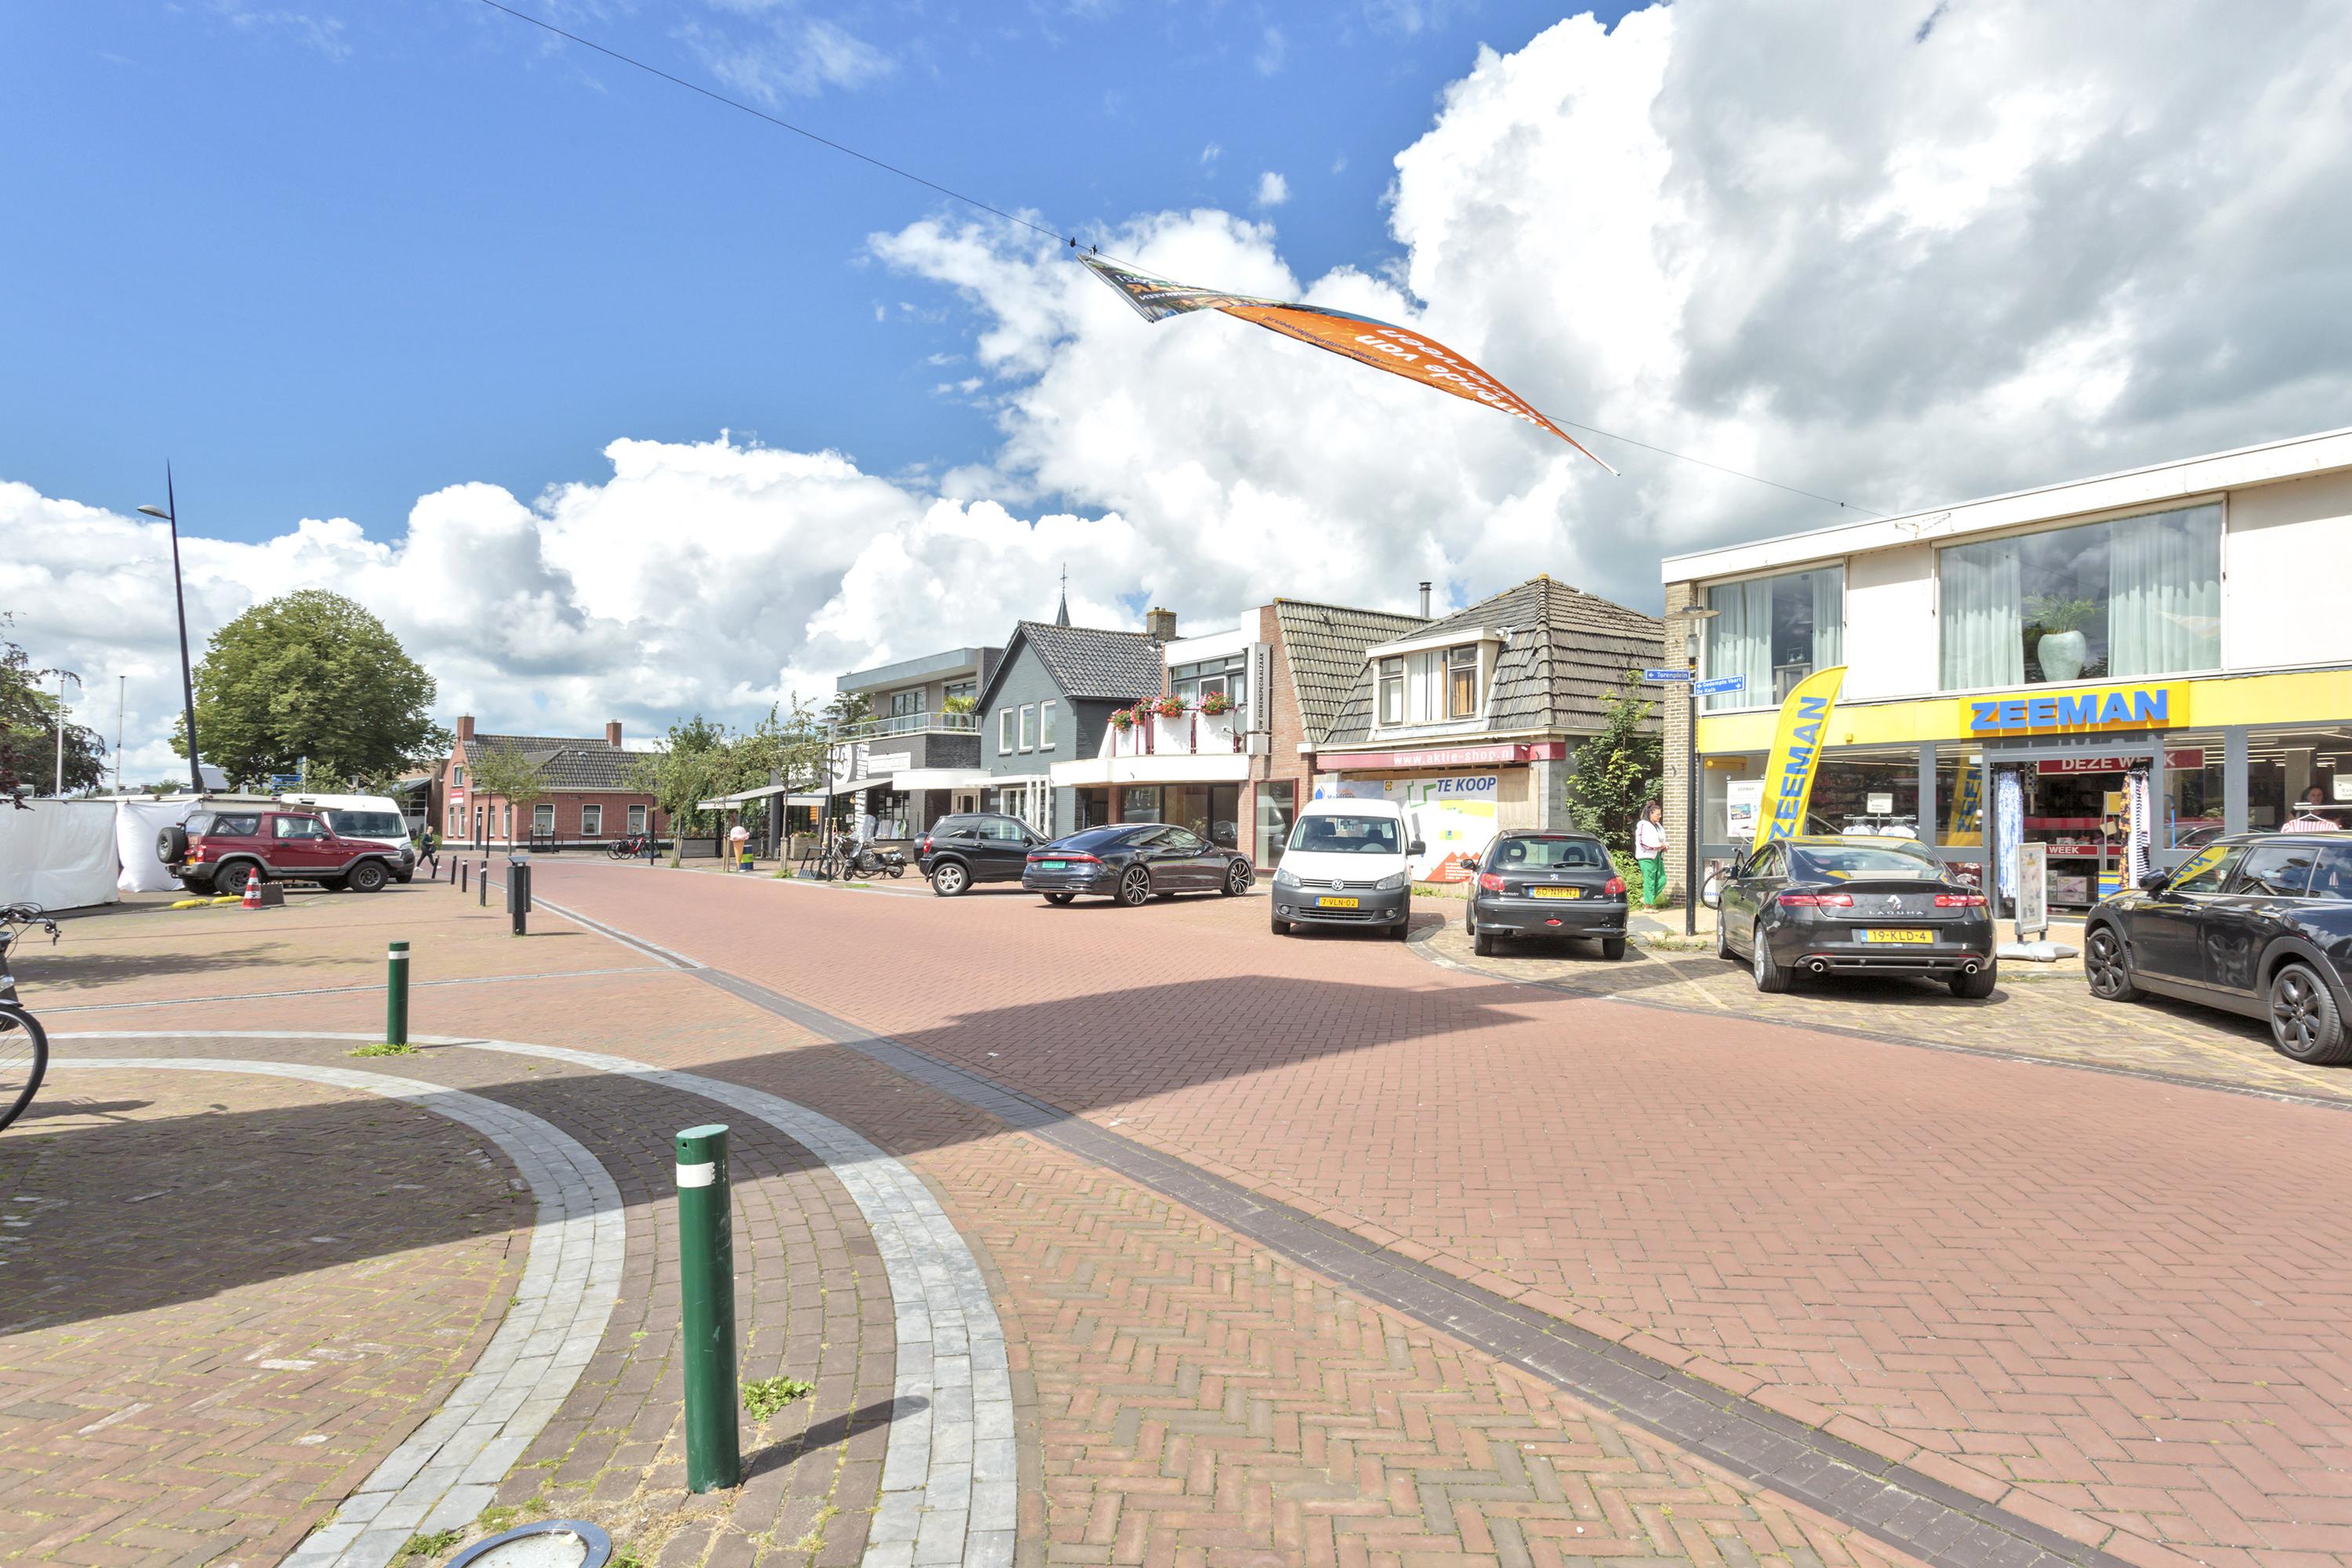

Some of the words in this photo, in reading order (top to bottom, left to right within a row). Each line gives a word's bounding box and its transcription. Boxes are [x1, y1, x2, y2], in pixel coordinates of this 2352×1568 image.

[1354, 334, 1420, 362] van
[1970, 689, 2168, 730] ZEEMAN
[1258, 720, 1264, 730] UW
[1393, 746, 1514, 765] www.aktie-shop.nl
[2062, 757, 2113, 771] DEZE
[2118, 753, 2176, 768] WK
[1768, 696, 1828, 841] ZEEMAN
[1437, 779, 1453, 792] TE
[1456, 777, 1497, 791] KOOP
[1873, 931, 1926, 941] 19-KLD-4
